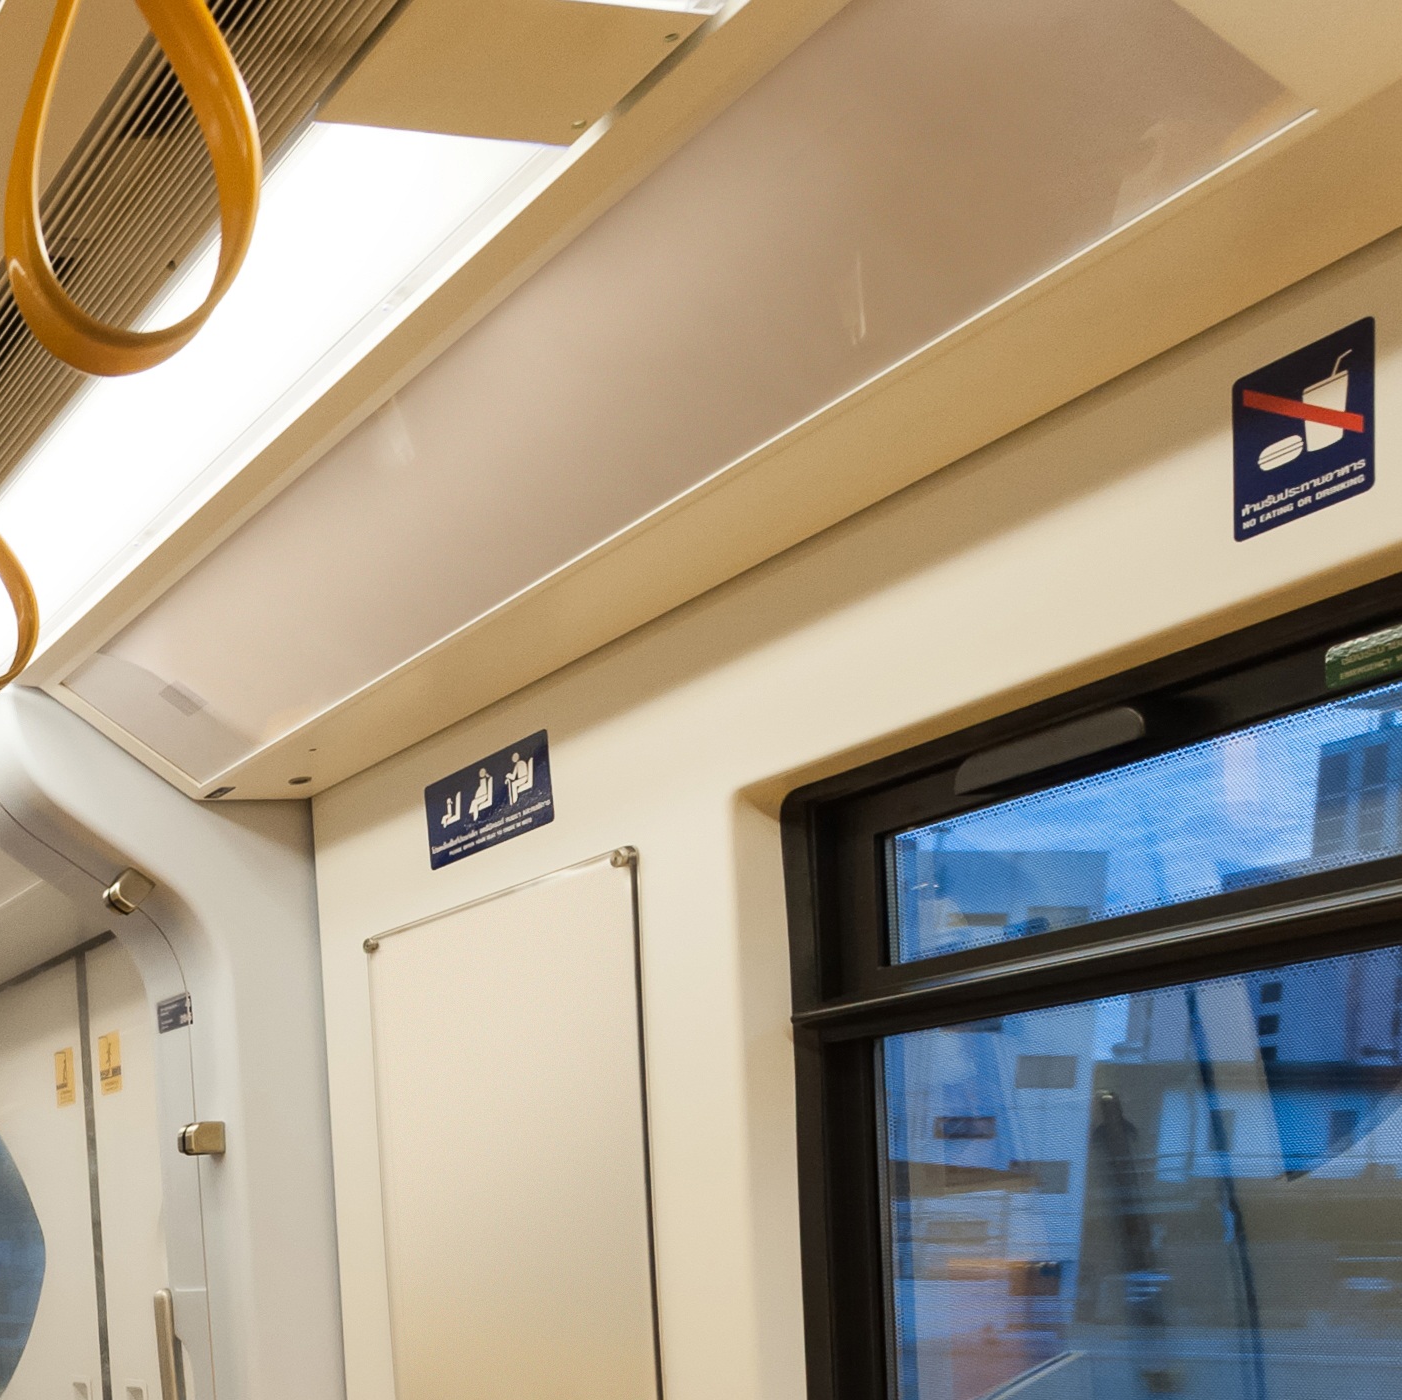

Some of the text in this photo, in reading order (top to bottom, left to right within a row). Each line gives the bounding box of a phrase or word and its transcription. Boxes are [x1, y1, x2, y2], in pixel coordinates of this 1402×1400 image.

[1242, 474, 1366, 530] NO EATING OR DRINKING
